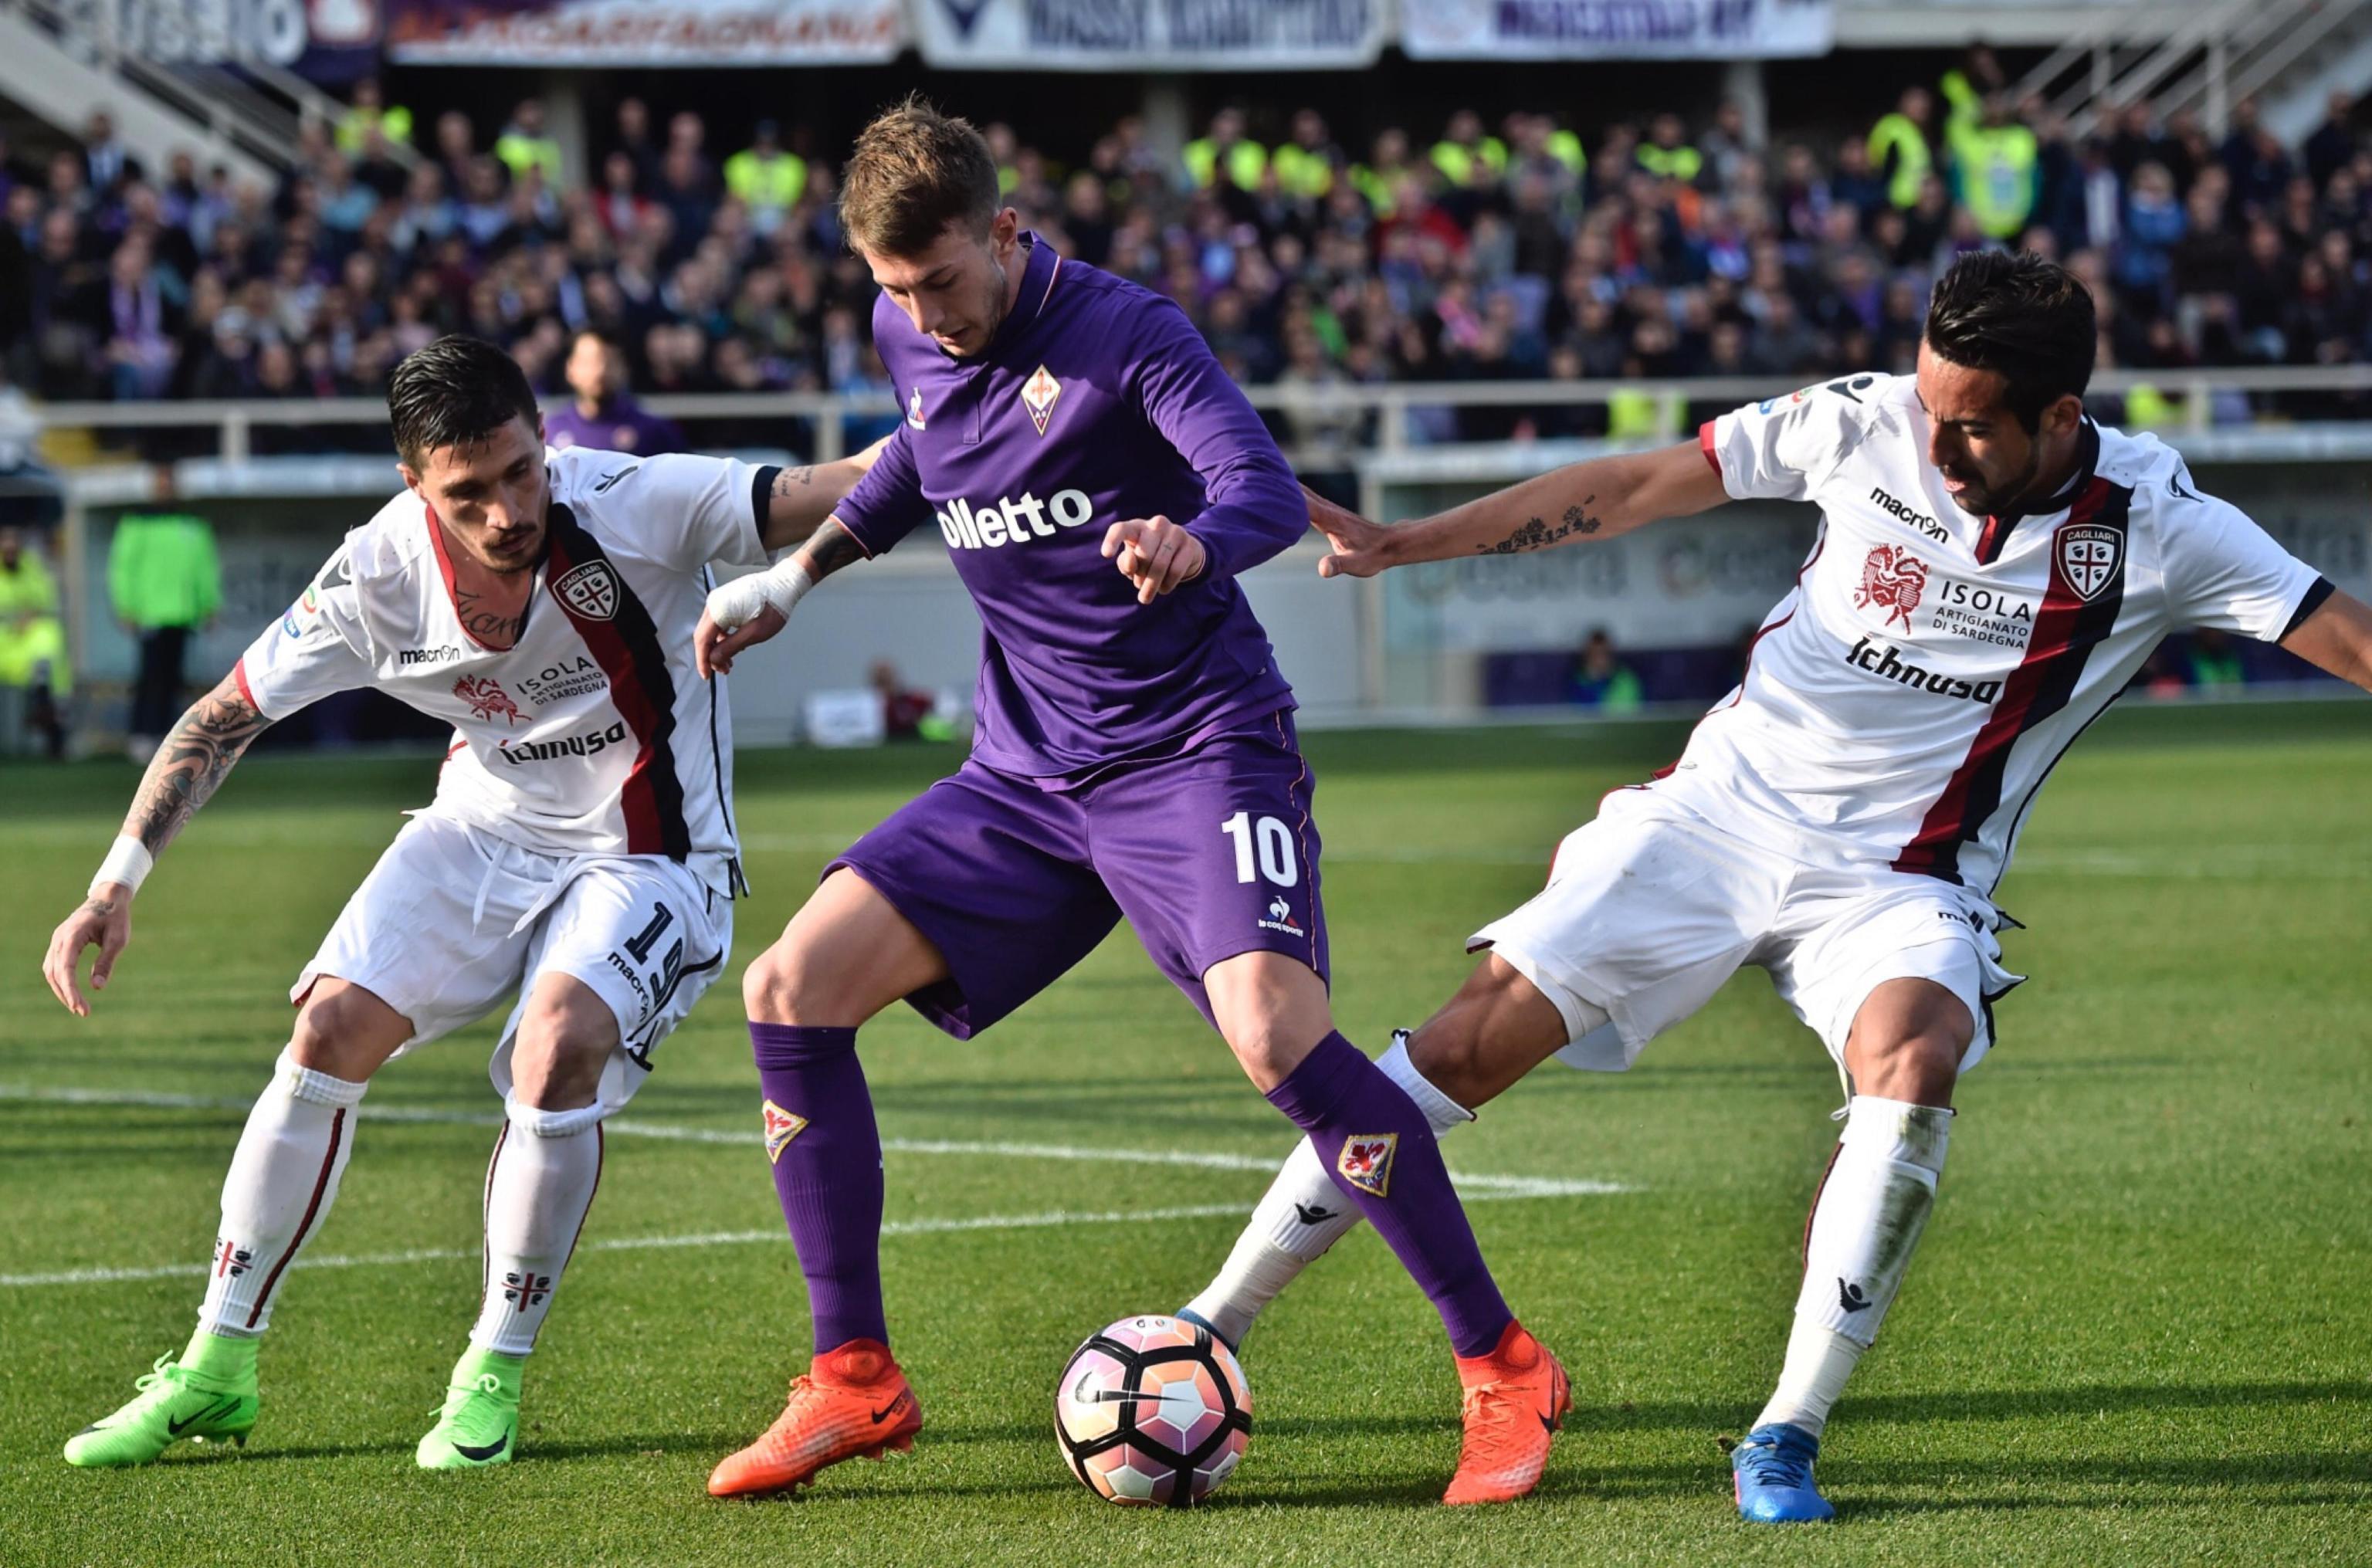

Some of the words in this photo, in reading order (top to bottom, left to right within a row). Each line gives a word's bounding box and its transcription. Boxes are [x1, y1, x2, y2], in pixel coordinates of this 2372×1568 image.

[937, 489, 1093, 550] olletto
[1869, 486, 1950, 544] macron
[2067, 530, 2115, 543] CAGLIARI
[561, 565, 601, 591] CAGLIARI
[1941, 581, 2031, 622] ISOLA
[1933, 618, 1947, 631] DI
[1952, 624, 2025, 649] SARDEGNA
[1936, 607, 2028, 636] ARTIGIANATO
[400, 645, 460, 665] macron
[516, 656, 595, 695] ISOLA
[530, 672, 603, 701] ARTIGIANATO
[535, 696, 548, 706] DI
[549, 680, 608, 701] SARDEGNA
[1221, 811, 1299, 888] 10
